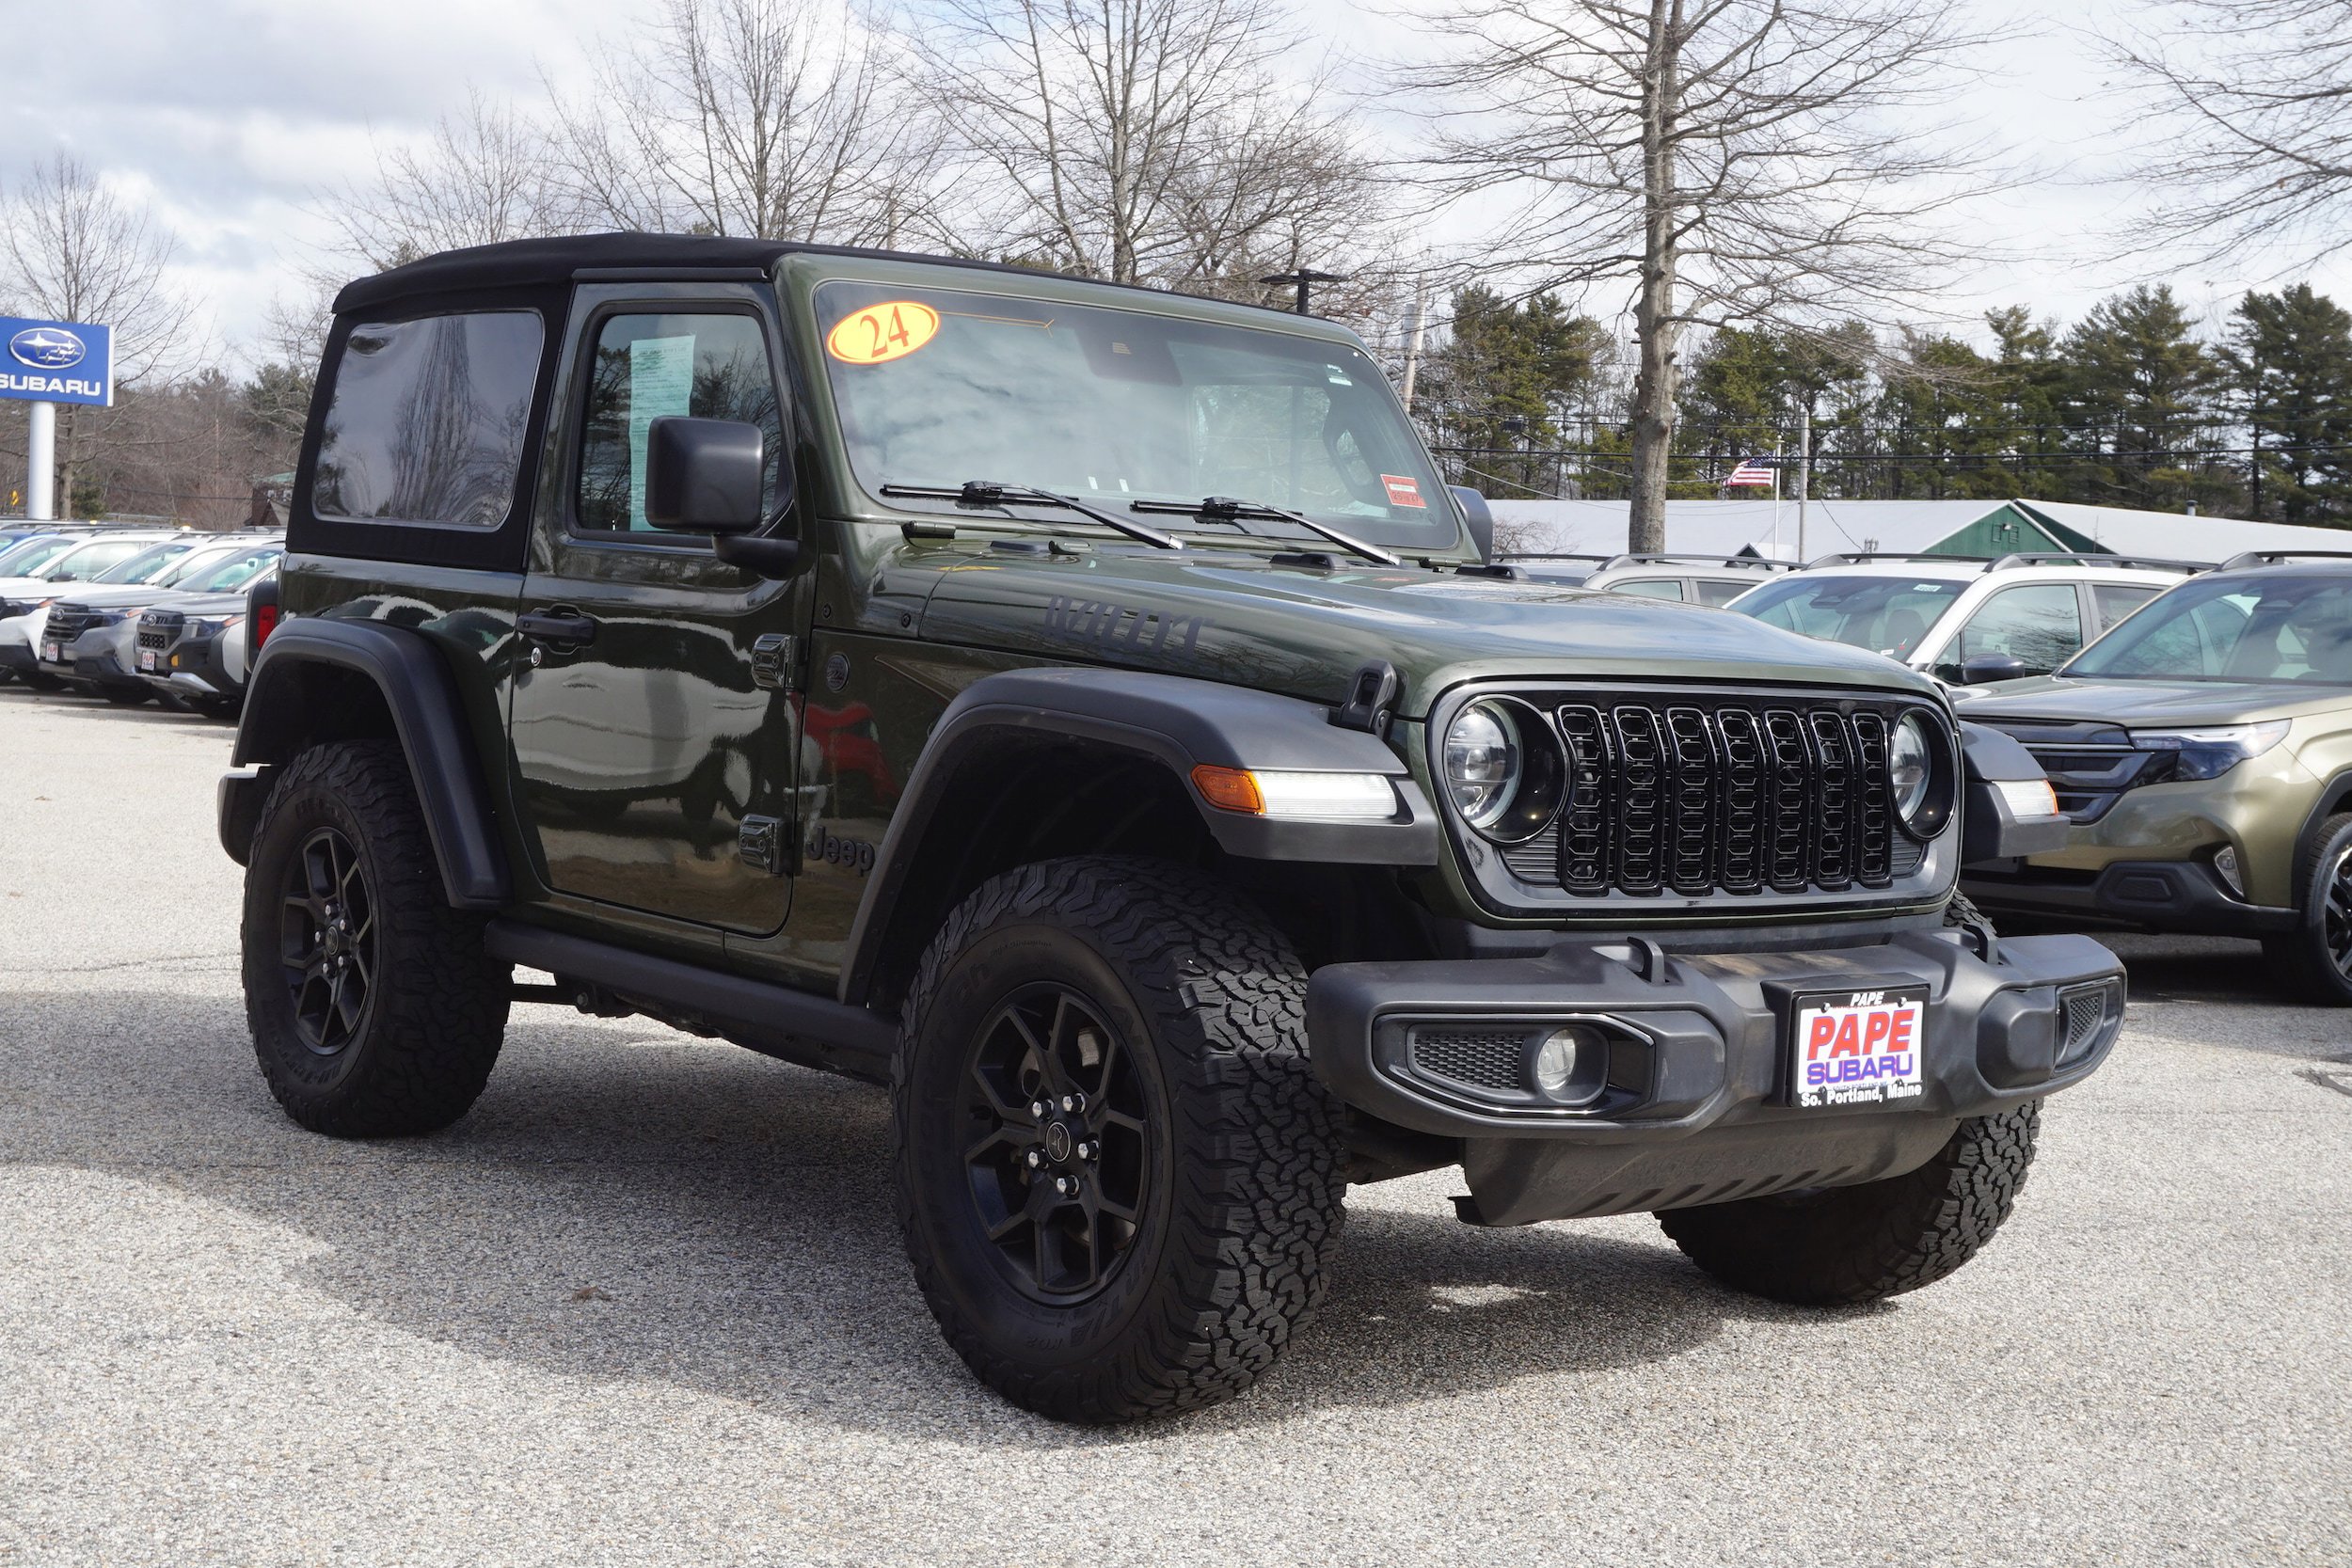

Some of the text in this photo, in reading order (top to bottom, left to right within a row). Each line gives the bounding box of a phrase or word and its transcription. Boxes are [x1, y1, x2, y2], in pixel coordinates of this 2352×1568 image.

[859, 305, 910, 358] 24
[804, 826, 876, 878] Jeep
[1850, 991, 1885, 1007] PAPE
[1806, 1008, 1915, 1061] PAPE
[1806, 1053, 1914, 1086] SUBARU
[1800, 1084, 1922, 1108] So. Portland, Maine
